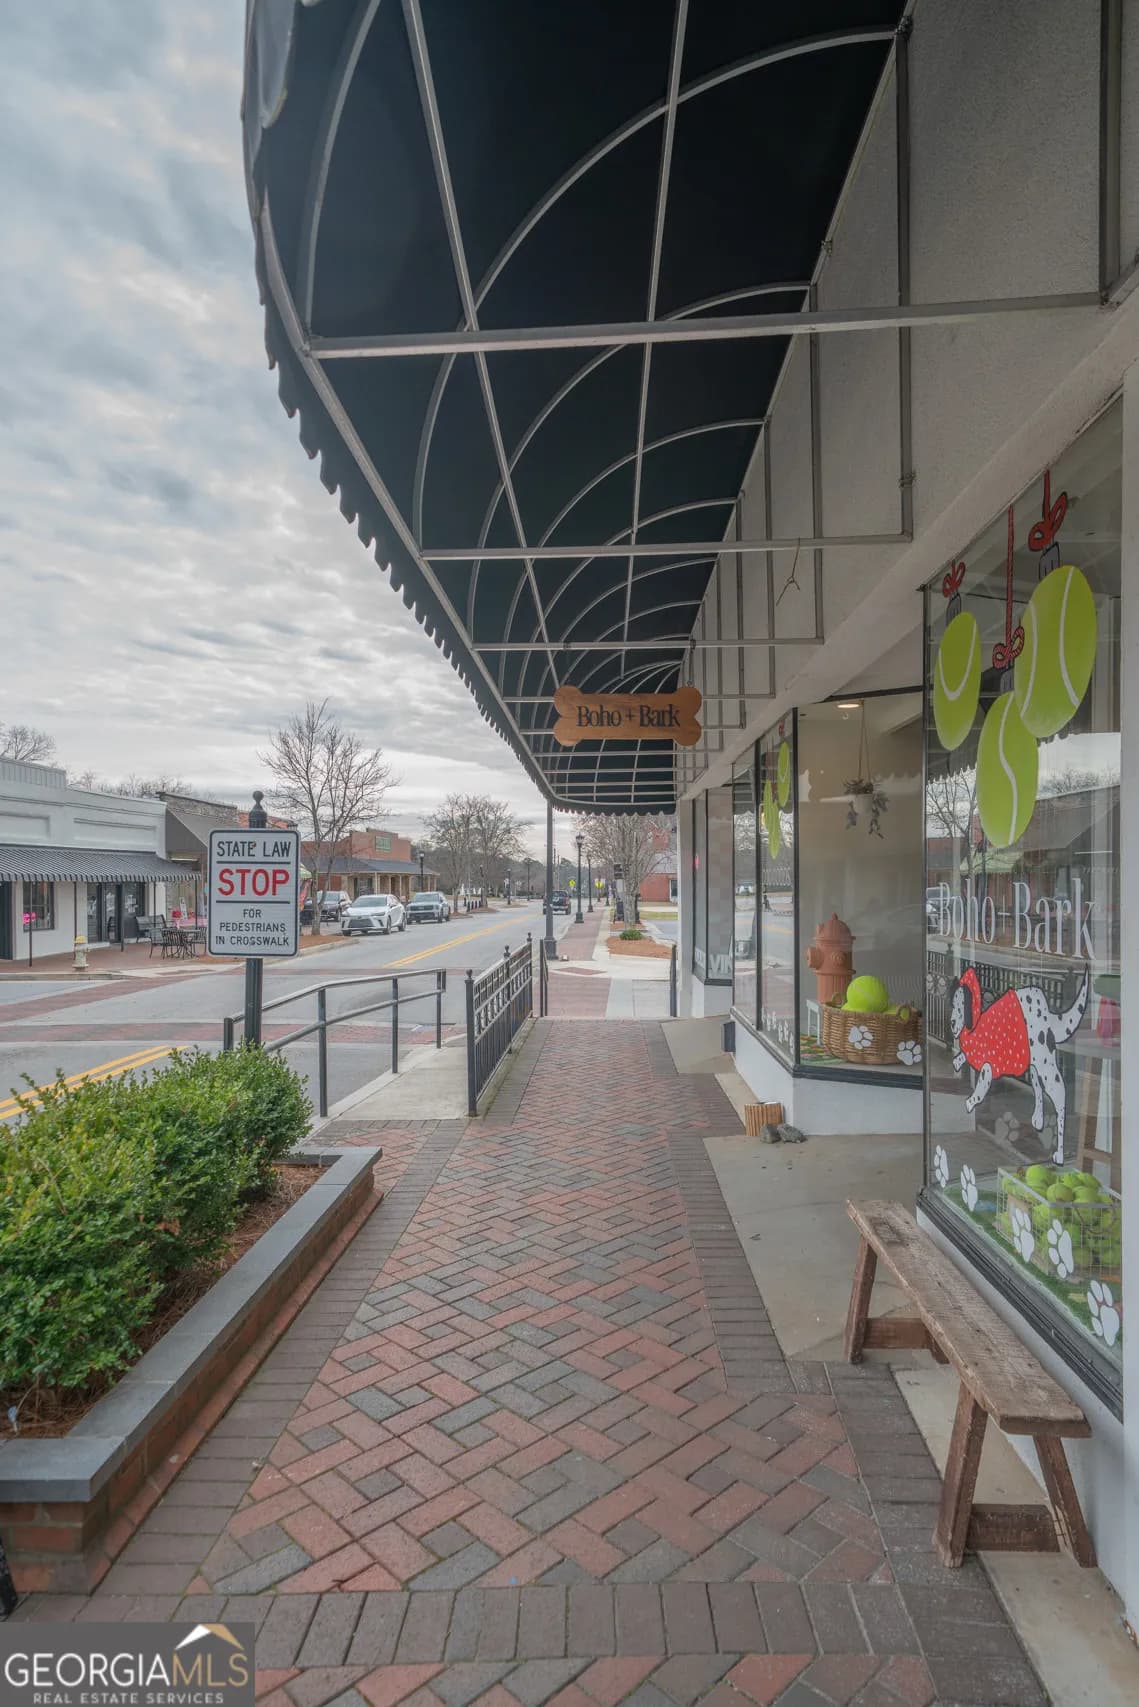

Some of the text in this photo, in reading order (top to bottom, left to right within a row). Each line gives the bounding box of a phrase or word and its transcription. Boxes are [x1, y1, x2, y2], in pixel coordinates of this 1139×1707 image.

[576, 704, 622, 727] Boho
[639, 704, 681, 728] Bark
[217, 841, 291, 857] STATE LAW
[217, 868, 290, 896] STOP
[243, 908, 262, 918] FOR
[1013, 878, 1096, 961] Bark
[220, 922, 287, 933] PEDESTRIANS
[215, 936, 290, 946] IN CROSSWALK
